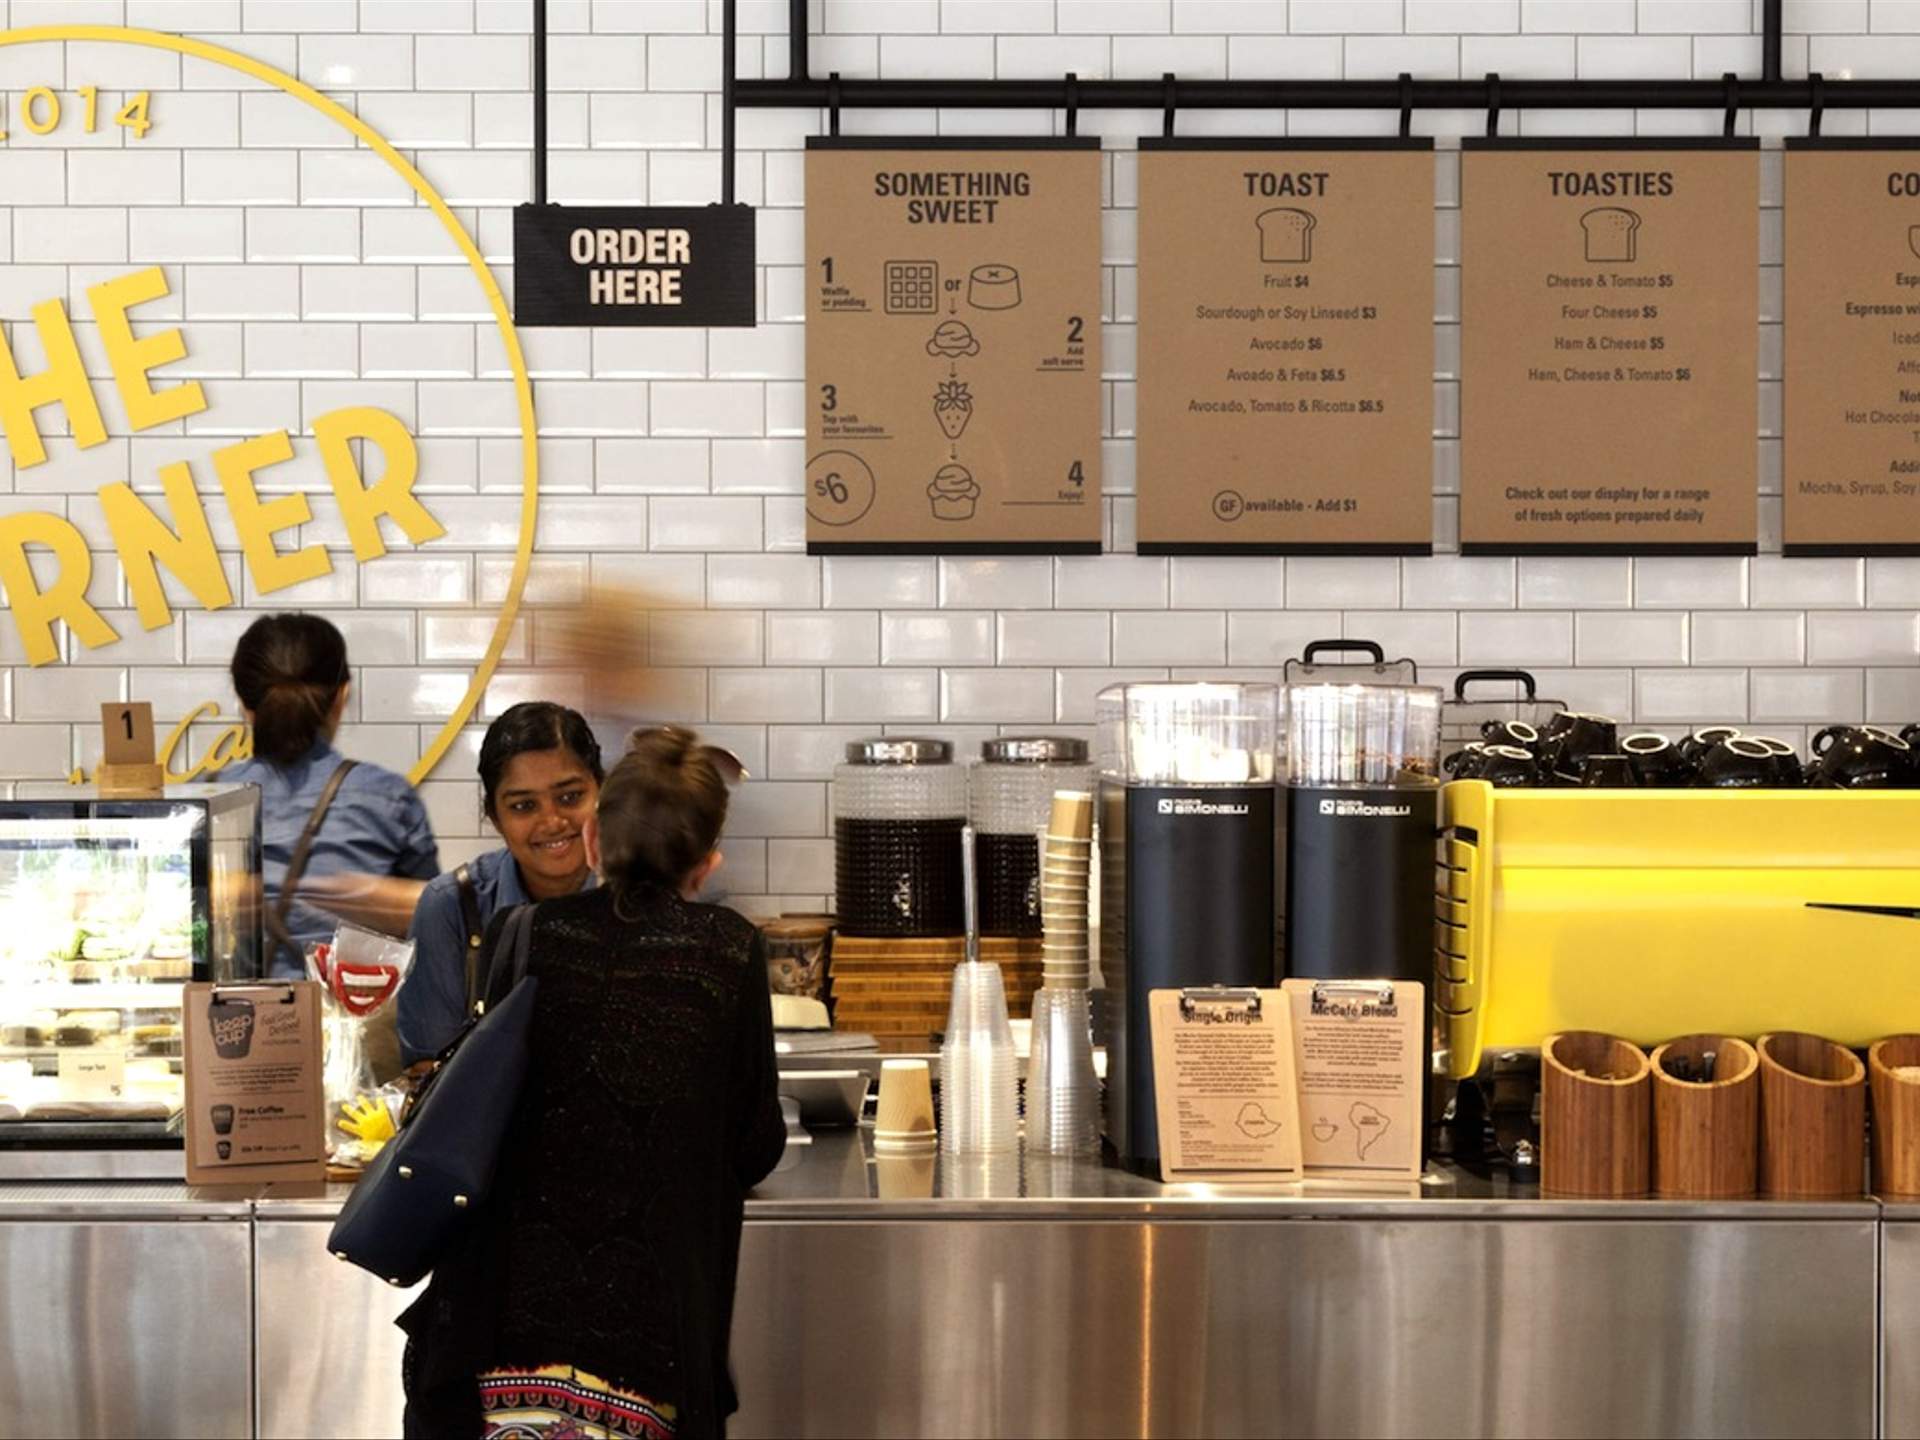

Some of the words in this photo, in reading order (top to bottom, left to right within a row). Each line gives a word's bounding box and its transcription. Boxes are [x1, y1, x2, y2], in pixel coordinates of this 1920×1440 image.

[0, 85, 151, 142] 014
[875, 172, 1030, 197] SOMETHING
[1243, 171, 1330, 198] TOAST
[1547, 171, 1674, 197] TOASTIES
[907, 199, 1000, 225] SWEET
[570, 228, 691, 265] ORDER
[821, 256, 833, 284] 1
[590, 269, 682, 305] HERE
[944, 279, 962, 292] or
[1263, 274, 1292, 288] Fruit
[1294, 274, 1310, 289] $4
[1546, 274, 1593, 288] Cheese
[1596, 274, 1607, 288] &
[1610, 274, 1656, 288] Tomato
[1658, 274, 1674, 288] $5
[1195, 305, 1265, 321] Sourdough
[1267, 308, 1281, 319] or
[1283, 305, 1308, 321] Soy
[1310, 306, 1359, 319] Linseed
[1361, 306, 1377, 320] $3
[1562, 305, 1590, 319] Four
[1593, 305, 1640, 319] Cheese
[1642, 305, 1658, 319] $5
[1845, 301, 1903, 318] Espresso
[1066, 316, 1084, 343] 2
[1250, 337, 1305, 351] Avocado
[1307, 337, 1323, 351] $6
[1554, 337, 1583, 350] Ham
[1586, 337, 1597, 350] &
[1600, 337, 1647, 350] Cheese
[1649, 337, 1665, 351] $5
[1276, 368, 1288, 382] &
[1291, 368, 1317, 381] Feta
[1320, 368, 1346, 382] $6.5
[1528, 368, 1561, 382] Ham,
[1564, 368, 1610, 381] Cheese
[1613, 368, 1624, 381] &
[1627, 368, 1673, 381] Tomato
[821, 384, 837, 411] 3
[1188, 399, 1247, 413] Avocado,
[1250, 399, 1295, 413] Tomato
[1298, 399, 1309, 412] &
[1312, 399, 1356, 412] Ricotta
[1358, 399, 1384, 413] $6.5
[1845, 410, 1867, 424] Hot
[1067, 460, 1084, 487] 4
[1505, 486, 1545, 500] Check
[1547, 488, 1569, 500] out
[1571, 490, 1592, 500] our
[1594, 487, 1639, 503] display
[1642, 487, 1660, 500] for
[1663, 490, 1671, 500] a
[1674, 489, 1710, 502] range
[1849, 480, 1889, 497] Syrup,
[1893, 480, 1917, 496] Soy
[1219, 499, 1237, 513] GF
[1245, 499, 1304, 512] available
[1315, 499, 1341, 512] Add
[1343, 498, 1357, 512] $1
[1514, 508, 1528, 521] of
[1530, 508, 1563, 521] fresh
[1565, 509, 1612, 524] options
[1614, 508, 1671, 524] prepared
[1673, 509, 1704, 524] daily
[120, 709, 133, 740] 1
